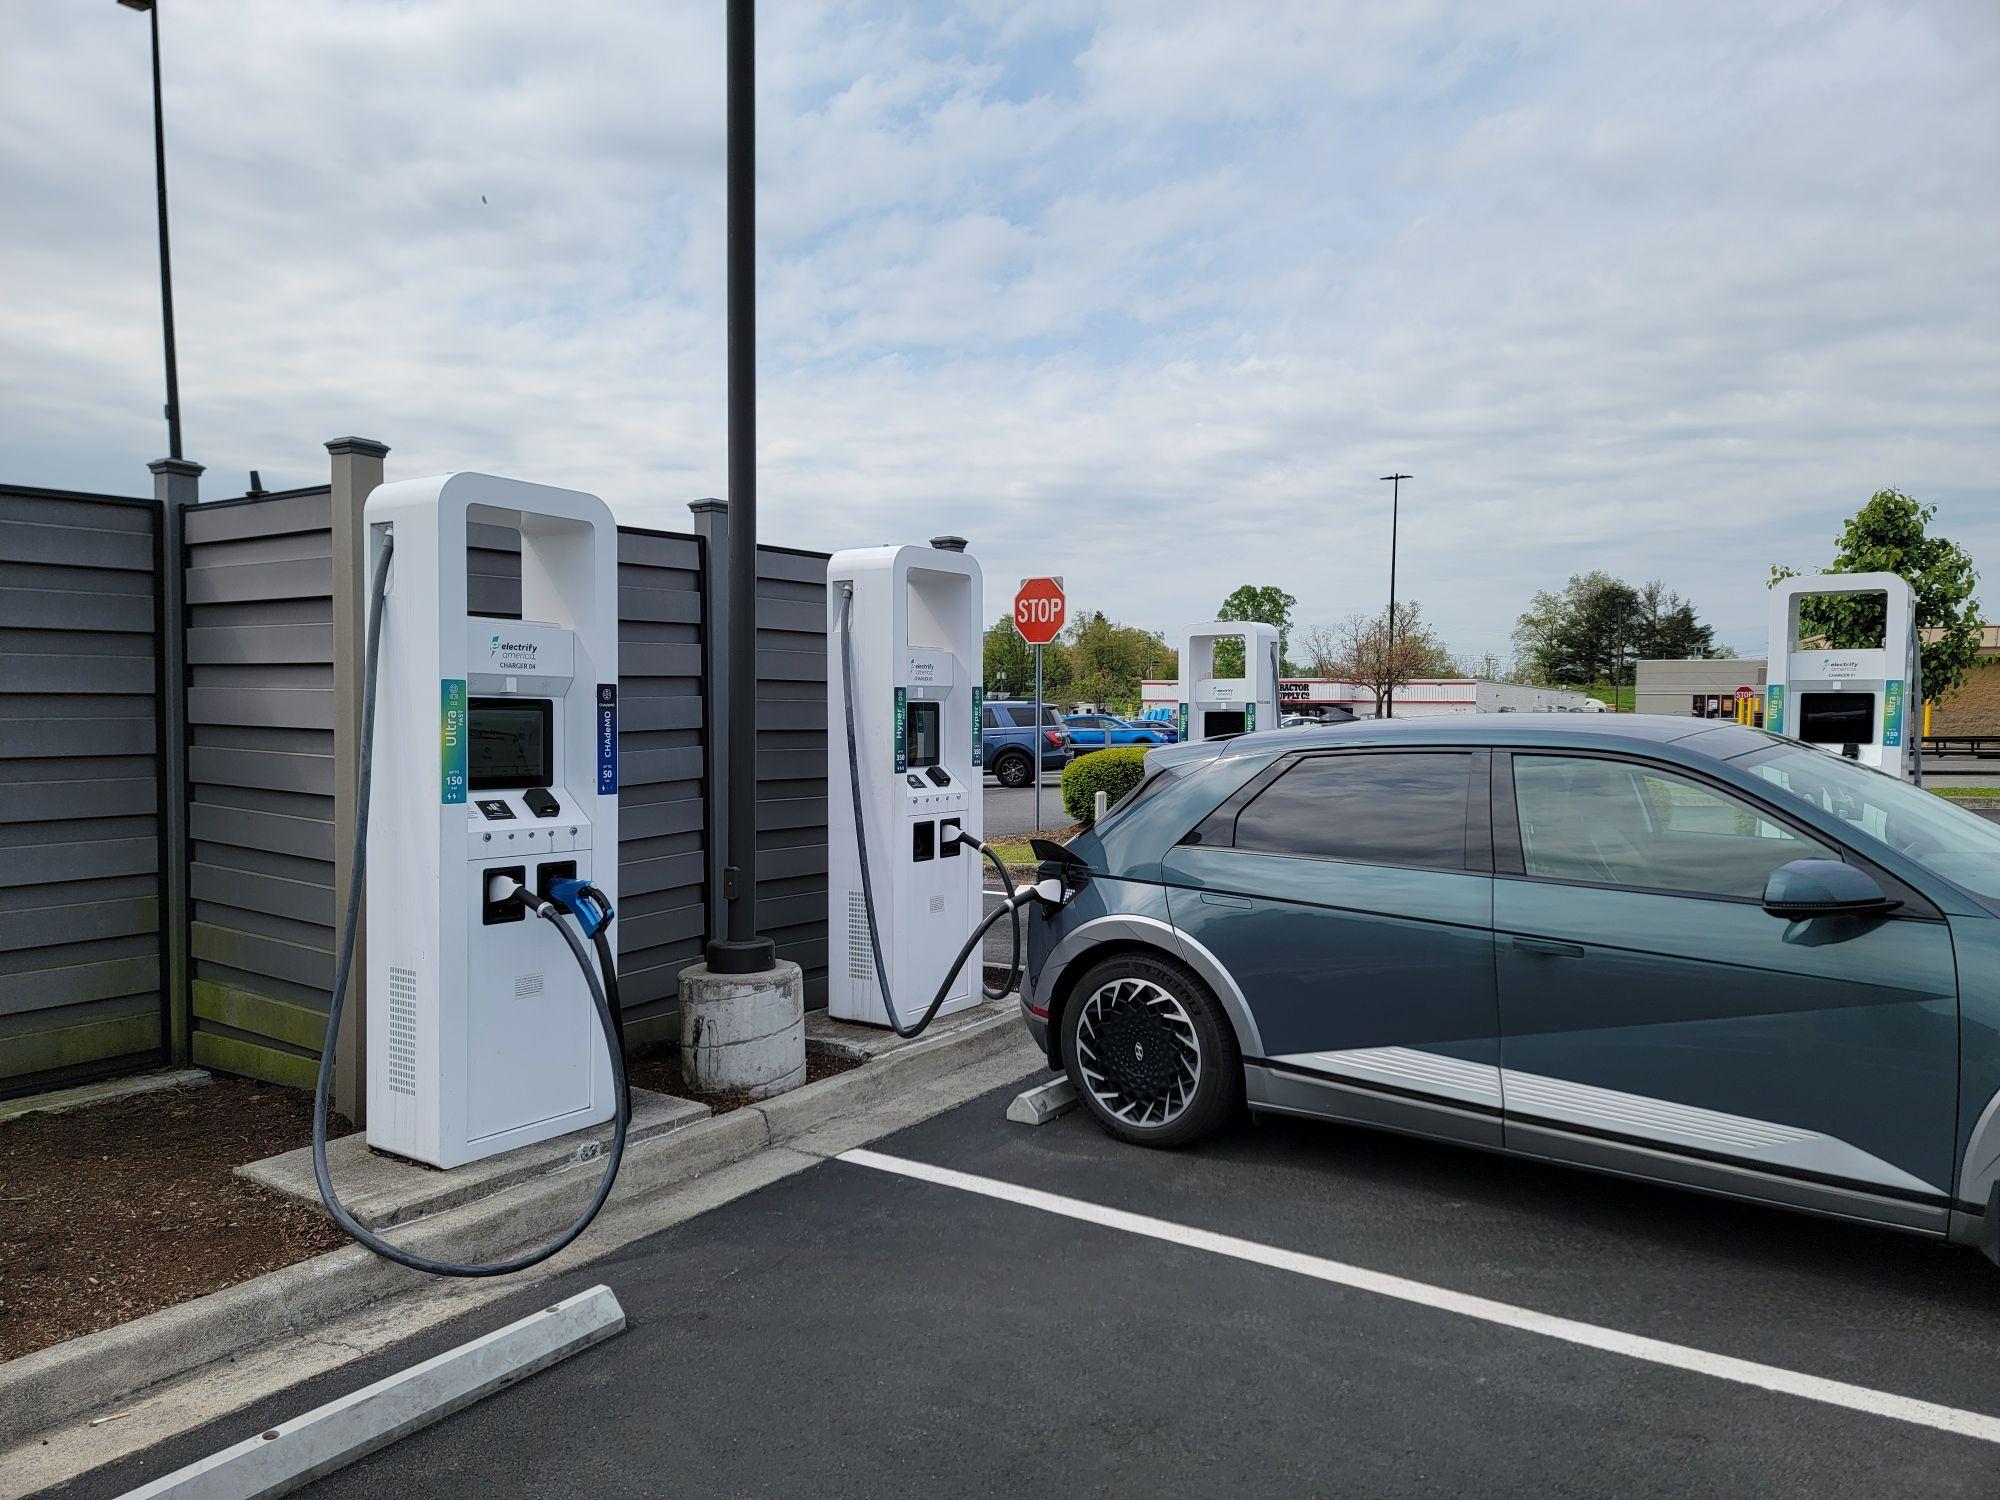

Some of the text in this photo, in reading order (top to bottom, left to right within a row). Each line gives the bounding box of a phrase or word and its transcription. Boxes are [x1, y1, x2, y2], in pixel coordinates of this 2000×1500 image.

[1017, 598, 1062, 623] STOP
[501, 643, 538, 653] electrify
[500, 662, 527, 670] CHARGER
[1280, 683, 1310, 691] RACTOR
[1769, 700, 1778, 719] Ultra
[1887, 696, 1896, 716] Ultra
[445, 710, 457, 746] Ultra
[603, 770, 612, 778] 50
[445, 776, 463, 785] 150
